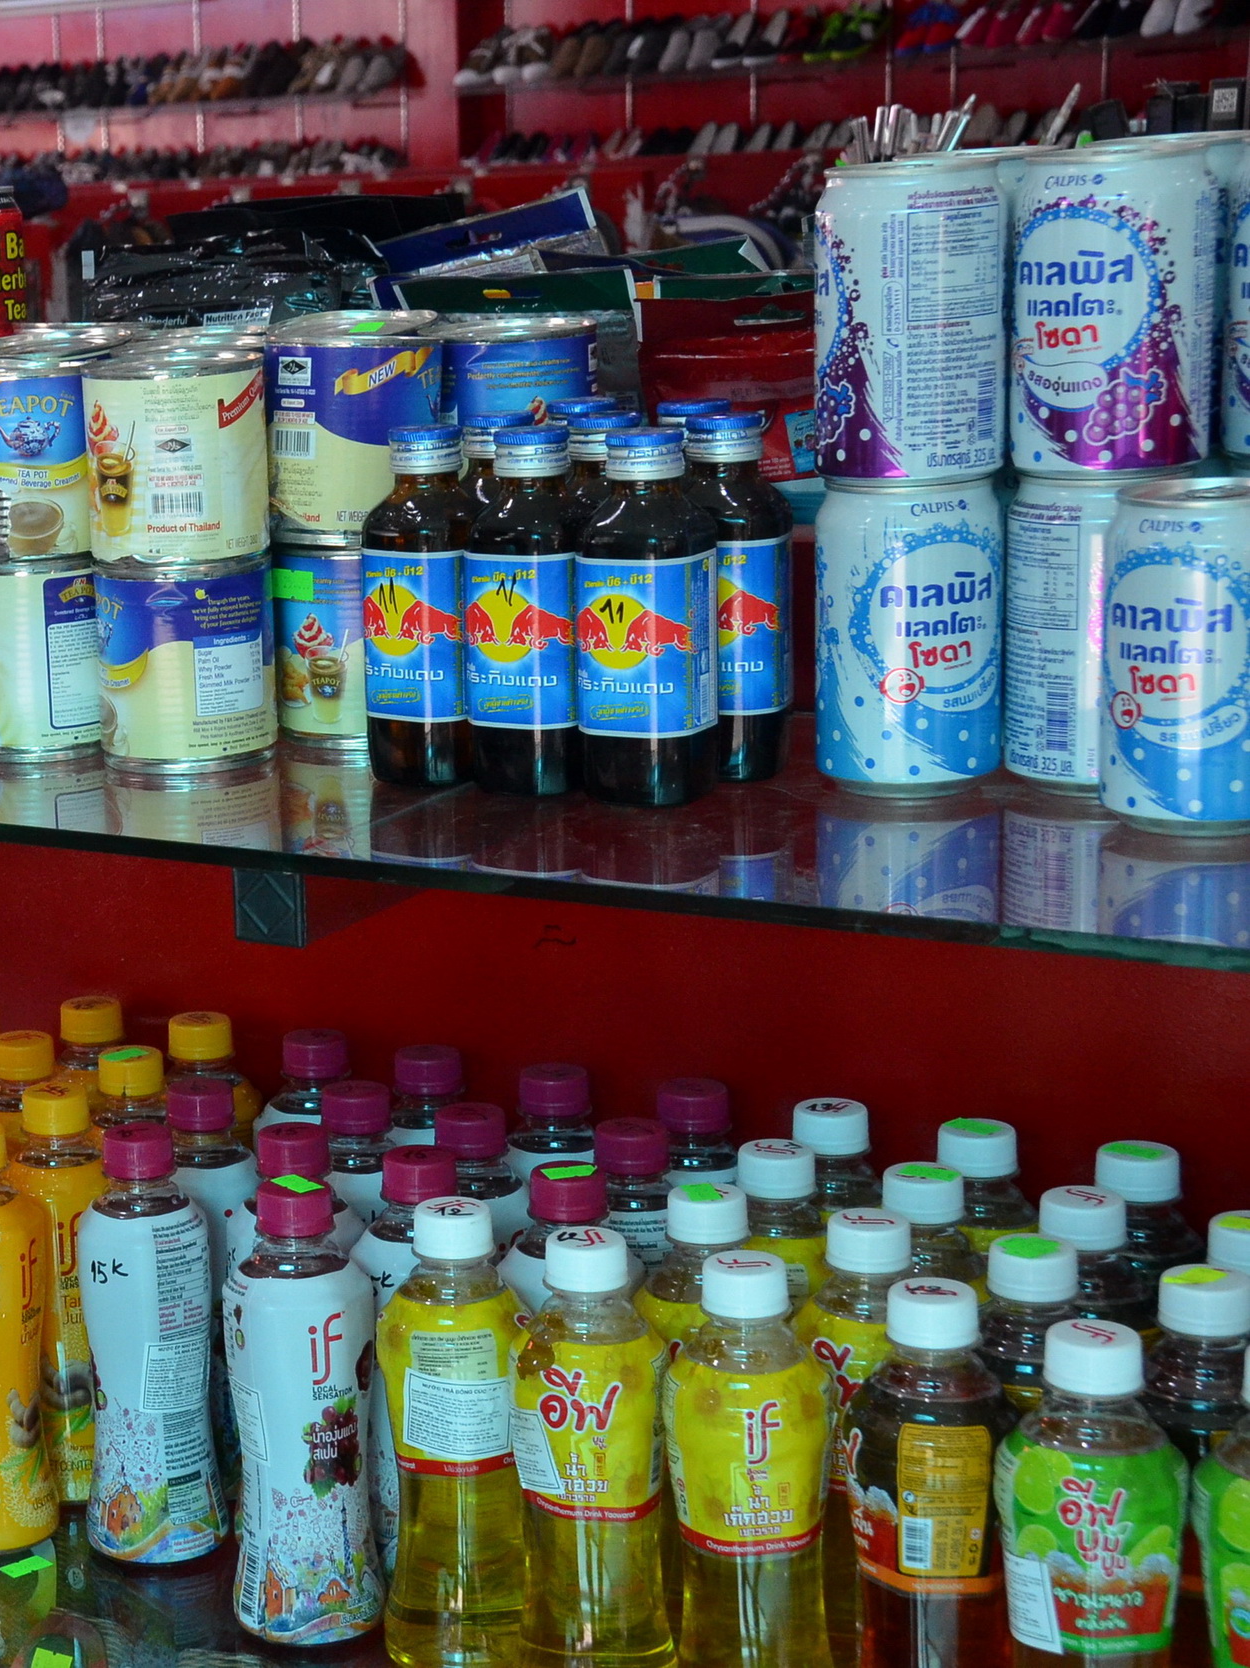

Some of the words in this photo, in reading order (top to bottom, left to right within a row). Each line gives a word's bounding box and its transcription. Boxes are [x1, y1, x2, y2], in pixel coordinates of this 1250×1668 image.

[1044, 174, 1087, 189] CALPIS
[1019, 249, 1134, 286] คาลพิส
[1026, 292, 1115, 317] แลคโตะ
[1035, 320, 1098, 350] โซดา
[368, 362, 396, 388] NEW
[17, 470, 32, 479] TEA
[34, 470, 48, 480] POT
[20, 478, 52, 489] Beverage
[54, 472, 80, 488] Creamer
[910, 500, 955, 517] CALPIS
[147, 523, 178, 534] Product
[179, 522, 187, 532] of
[188, 520, 221, 532] Thailand
[1139, 518, 1184, 534] CALPIS
[630, 573, 653, 586] บี12
[879, 572, 992, 609] คาลพิส
[1112, 597, 1233, 633] คาลพิส
[896, 611, 983, 638] แลคโตะ
[213, 635, 247, 646] Ingredients
[197, 649, 213, 657] Sugar
[908, 639, 973, 669] โซดา
[214, 664, 232, 672] Powder
[199, 681, 222, 689] Skimmed
[234, 677, 250, 685] Powder
[312, 677, 341, 686] TEAPOT
[1130, 665, 1196, 696] โซดา
[1041, 755, 1062, 771] 325
[19, 1238, 38, 1311] if
[307, 1310, 345, 1385] if
[312, 1386, 337, 1395] LOCAL
[312, 1386, 353, 1401] SENSATION
[539, 1366, 622, 1432] อีฟ
[745, 1402, 780, 1464] if
[747, 1485, 770, 1510] น้ำ
[1058, 1476, 1126, 1528] อีฟ
[583, 1508, 603, 1519] Drink
[766, 1541, 786, 1552] Drink
